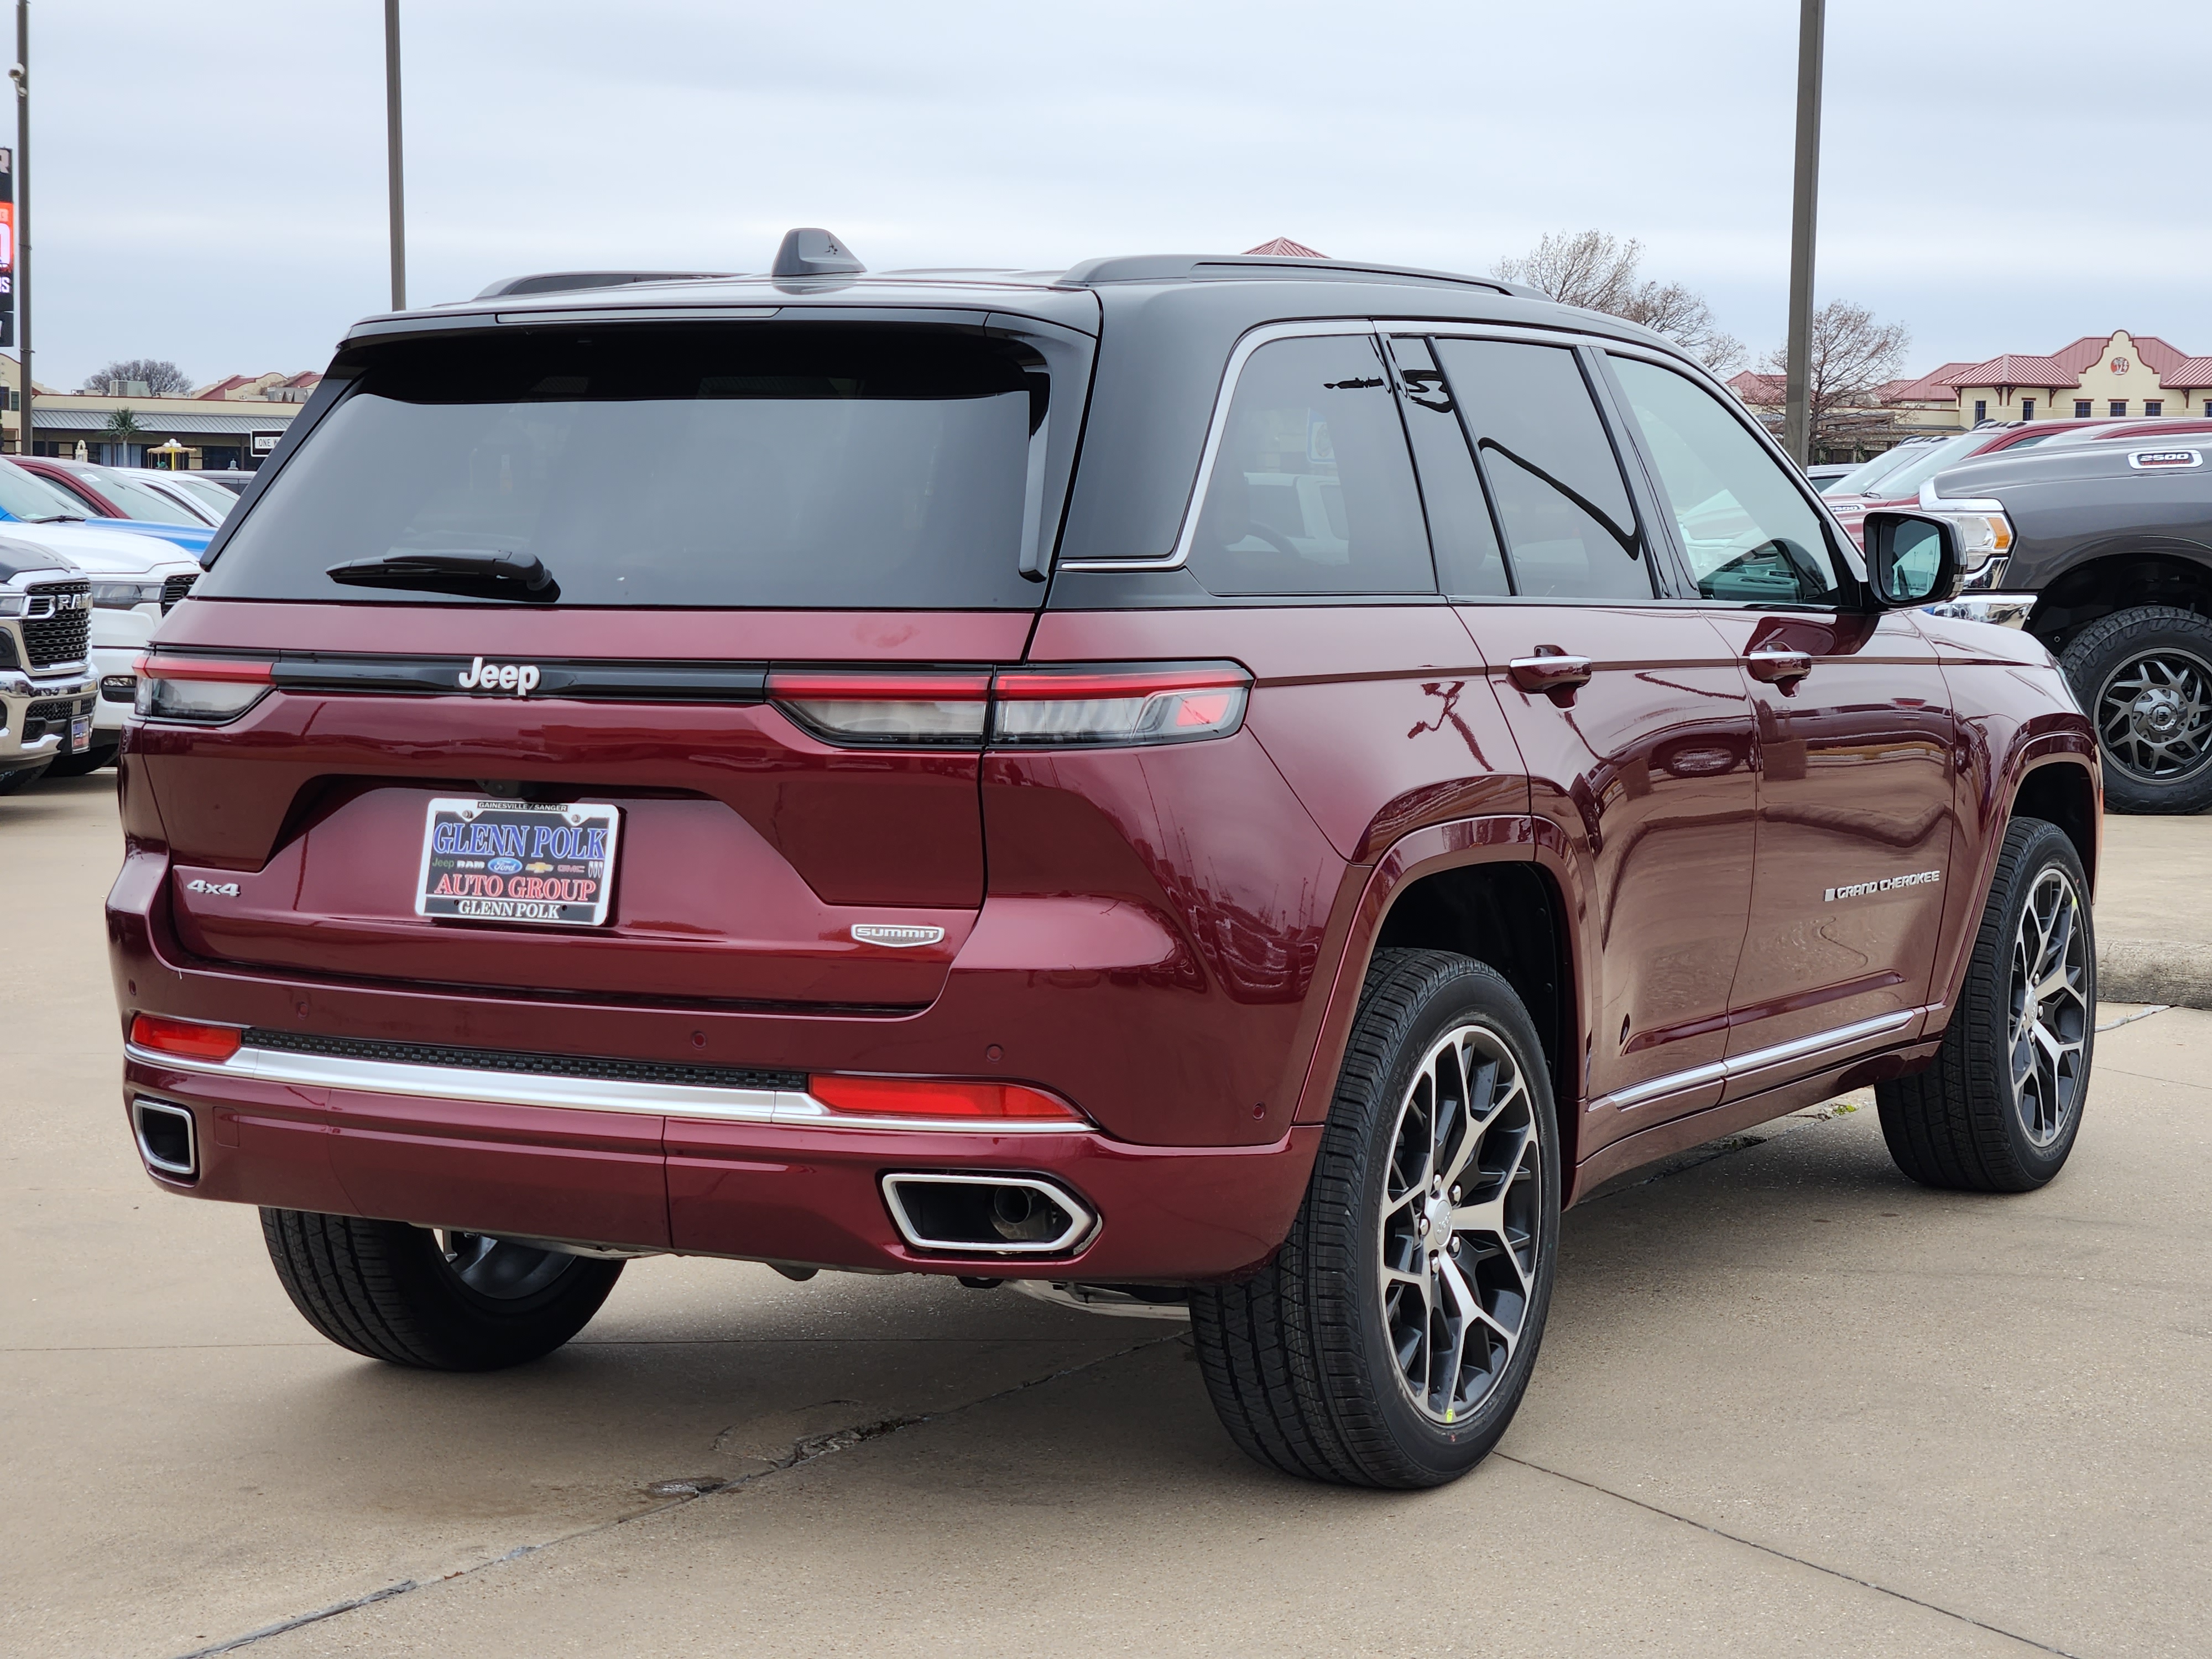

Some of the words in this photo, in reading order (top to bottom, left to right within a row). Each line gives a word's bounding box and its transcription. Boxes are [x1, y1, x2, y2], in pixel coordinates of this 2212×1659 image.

[259, 439, 271, 447] ONE
[57, 592, 93, 611] RAM
[458, 657, 540, 696] Jeep
[433, 822, 530, 857] GLENN
[531, 826, 608, 859] POLK
[432, 858, 454, 869] Jeep
[457, 860, 485, 869] RAM
[493, 860, 515, 872] Ford
[557, 864, 585, 873] GMC
[187, 879, 240, 896] 4x4
[434, 873, 504, 897] AUTO
[508, 876, 596, 901] GROUP
[1837, 881, 1878, 899] GRAND
[1879, 870, 1940, 891] CHEROKEE
[458, 900, 515, 916] GLENN
[515, 902, 561, 919] POLK
